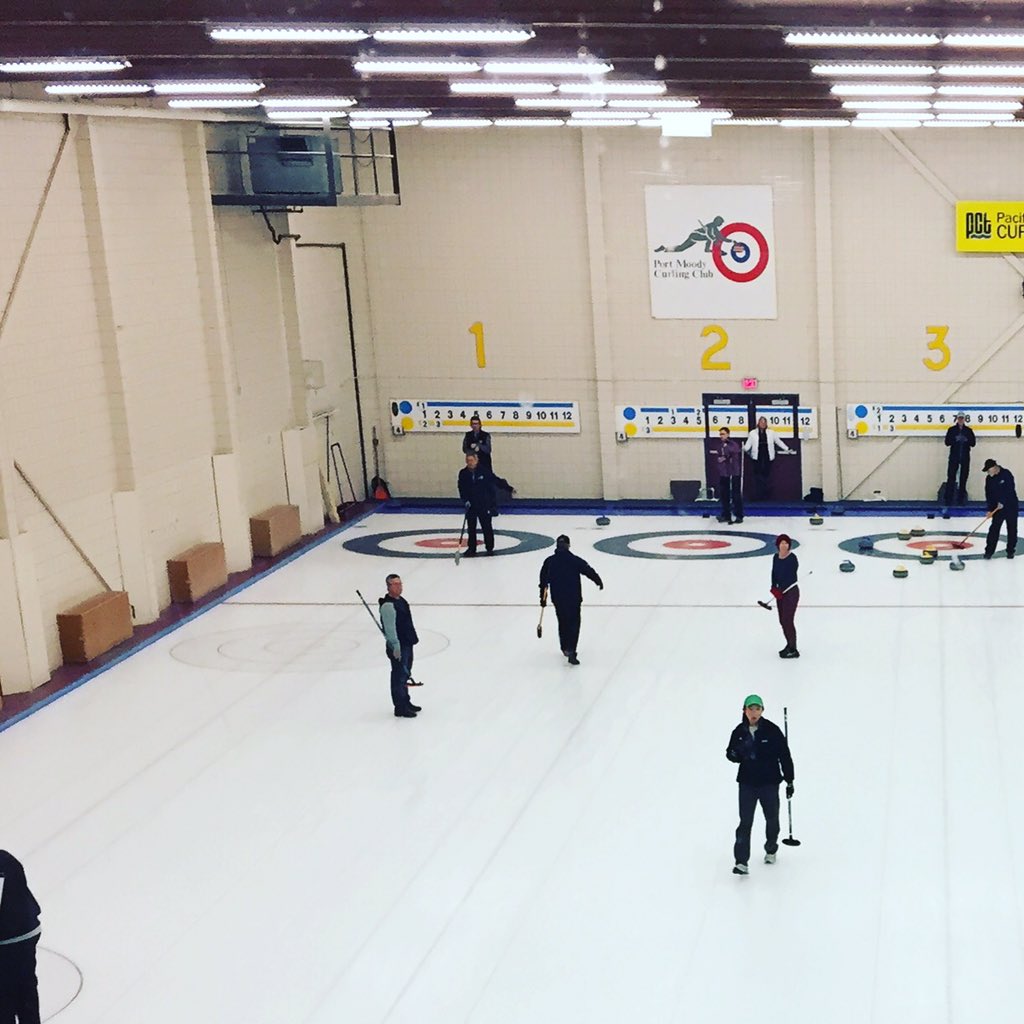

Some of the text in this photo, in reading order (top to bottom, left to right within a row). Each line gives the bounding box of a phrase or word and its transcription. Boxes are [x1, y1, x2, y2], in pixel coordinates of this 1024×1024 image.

[654, 259, 707, 270] Port Moody
[654, 269, 714, 279] Curling Club
[470, 323, 486, 368] 1
[701, 325, 731, 370] 2
[924, 326, 950, 371] 3
[422, 410, 427, 418] 1
[434, 410, 441, 418] 2
[447, 410, 453, 418] 3
[460, 410, 466, 418] 4
[486, 411, 492, 419] 6
[500, 411, 506, 419] 7
[513, 411, 519, 419] 8
[526, 411, 532, 419] 9
[536, 411, 546, 420] 10
[550, 411, 559, 420] 11
[562, 412, 572, 420] 12
[889, 415, 895, 423] 2
[902, 415, 907, 423] 3
[913, 415, 920, 423] 4
[927, 415, 933, 423] 5
[940, 415, 946, 423] 6
[965, 415, 971, 423] 8
[977, 415, 984, 423] 9
[988, 415, 999, 423] 10
[1002, 415, 1010, 423] 11
[1014, 415, 1024, 423] 12
[646, 416, 811, 425] 1 2 3 4 5 6 7 8 10 11 12
